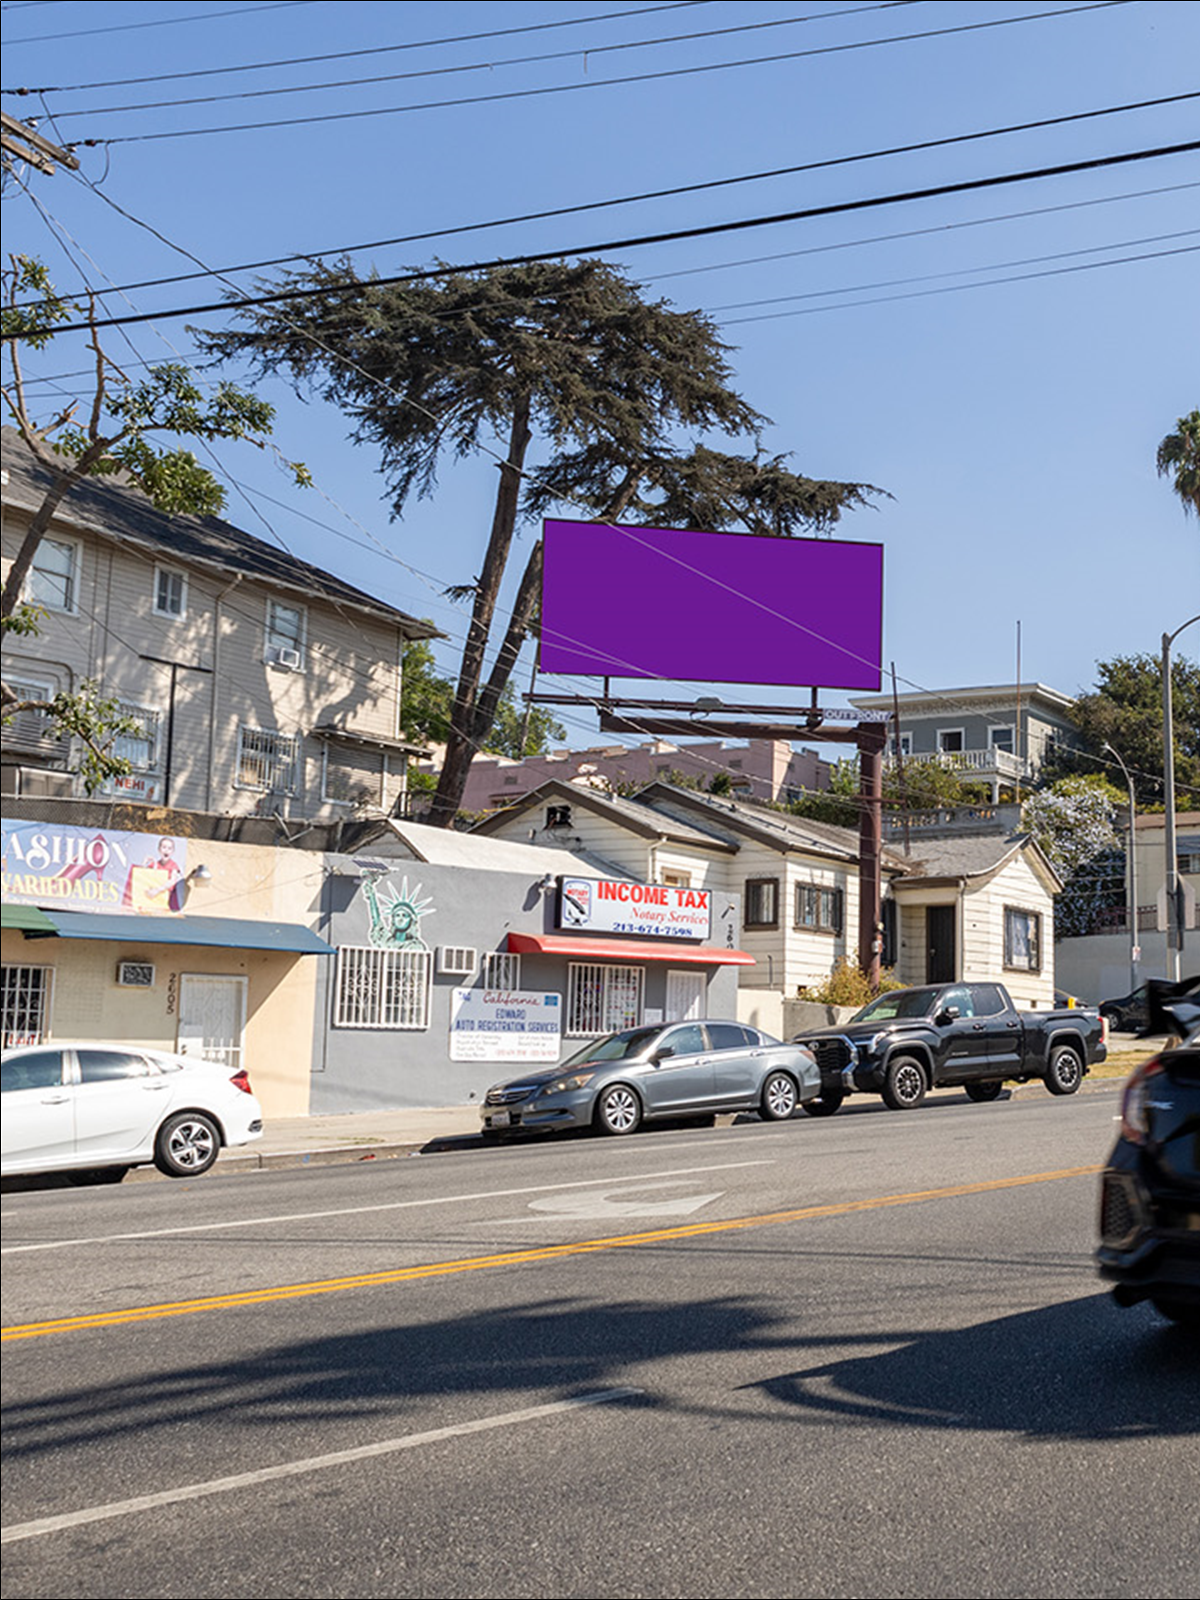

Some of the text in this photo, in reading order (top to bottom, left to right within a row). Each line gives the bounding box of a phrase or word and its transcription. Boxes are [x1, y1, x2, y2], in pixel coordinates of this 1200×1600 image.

[115, 777, 145, 791] NEHI
[1, 831, 128, 871] ASHION
[1, 872, 119, 903] VARIEDADES
[597, 881, 708, 910] INCOME TAX
[630, 907, 709, 925] Notary Services
[483, 991, 540, 1006] California
[496, 1008, 526, 1020] EDWARD
[456, 1020, 559, 1033] AUTO REGISTRATION SERVICES
